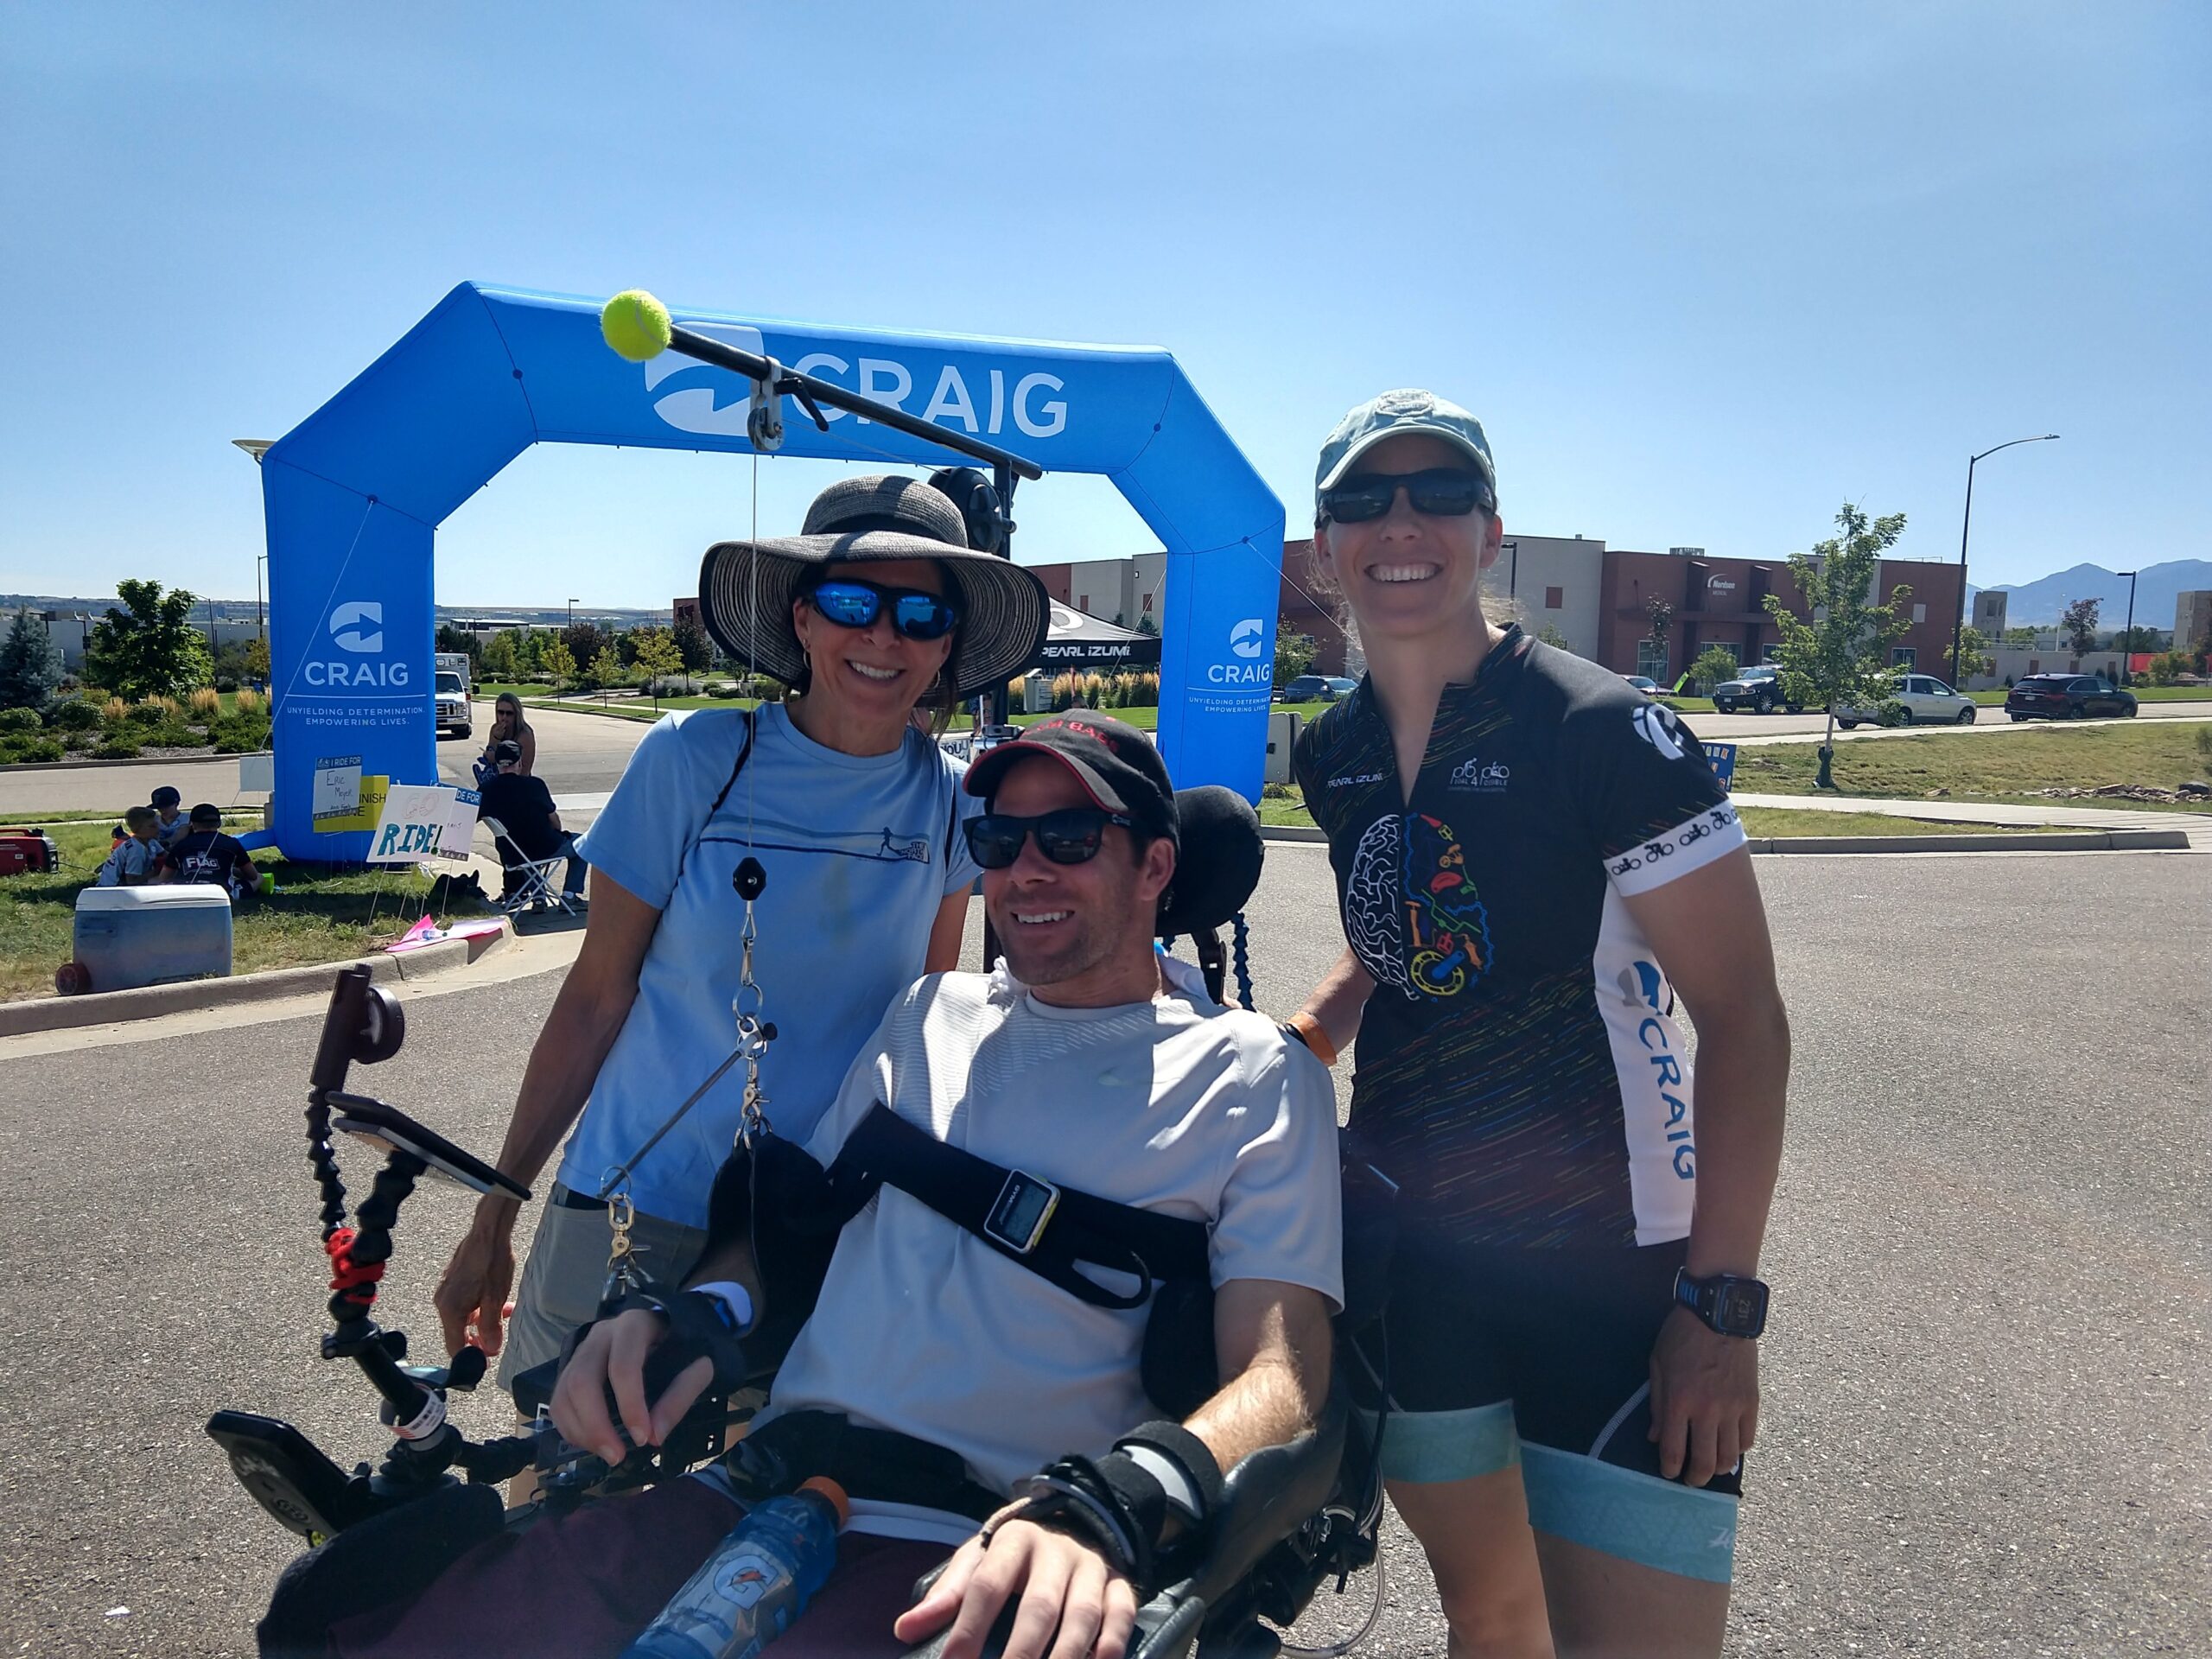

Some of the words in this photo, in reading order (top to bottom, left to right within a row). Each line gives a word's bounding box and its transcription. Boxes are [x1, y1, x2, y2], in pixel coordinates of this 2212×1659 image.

[792, 353, 1068, 438] CRAIG
[1041, 646, 1085, 658] PEARL
[304, 661, 409, 687] CRAIG
[1207, 663, 1270, 683] CRAIG
[1189, 696, 1234, 705] UNYIELDING
[287, 706, 344, 716] UNYIELDING
[348, 706, 425, 716] DETERMINATION.
[306, 717, 377, 727] EMPOWERING
[381, 717, 410, 726] LIVES.
[334, 757, 348, 766] RIDE
[349, 756, 361, 765] FOR
[359, 792, 387, 804] INISH
[455, 790, 465, 801] DE
[466, 792, 480, 804] FOR
[377, 823, 443, 856] RIDE!
[186, 857, 218, 868] FLAG
[1638, 1017, 1696, 1180] CRAIG
